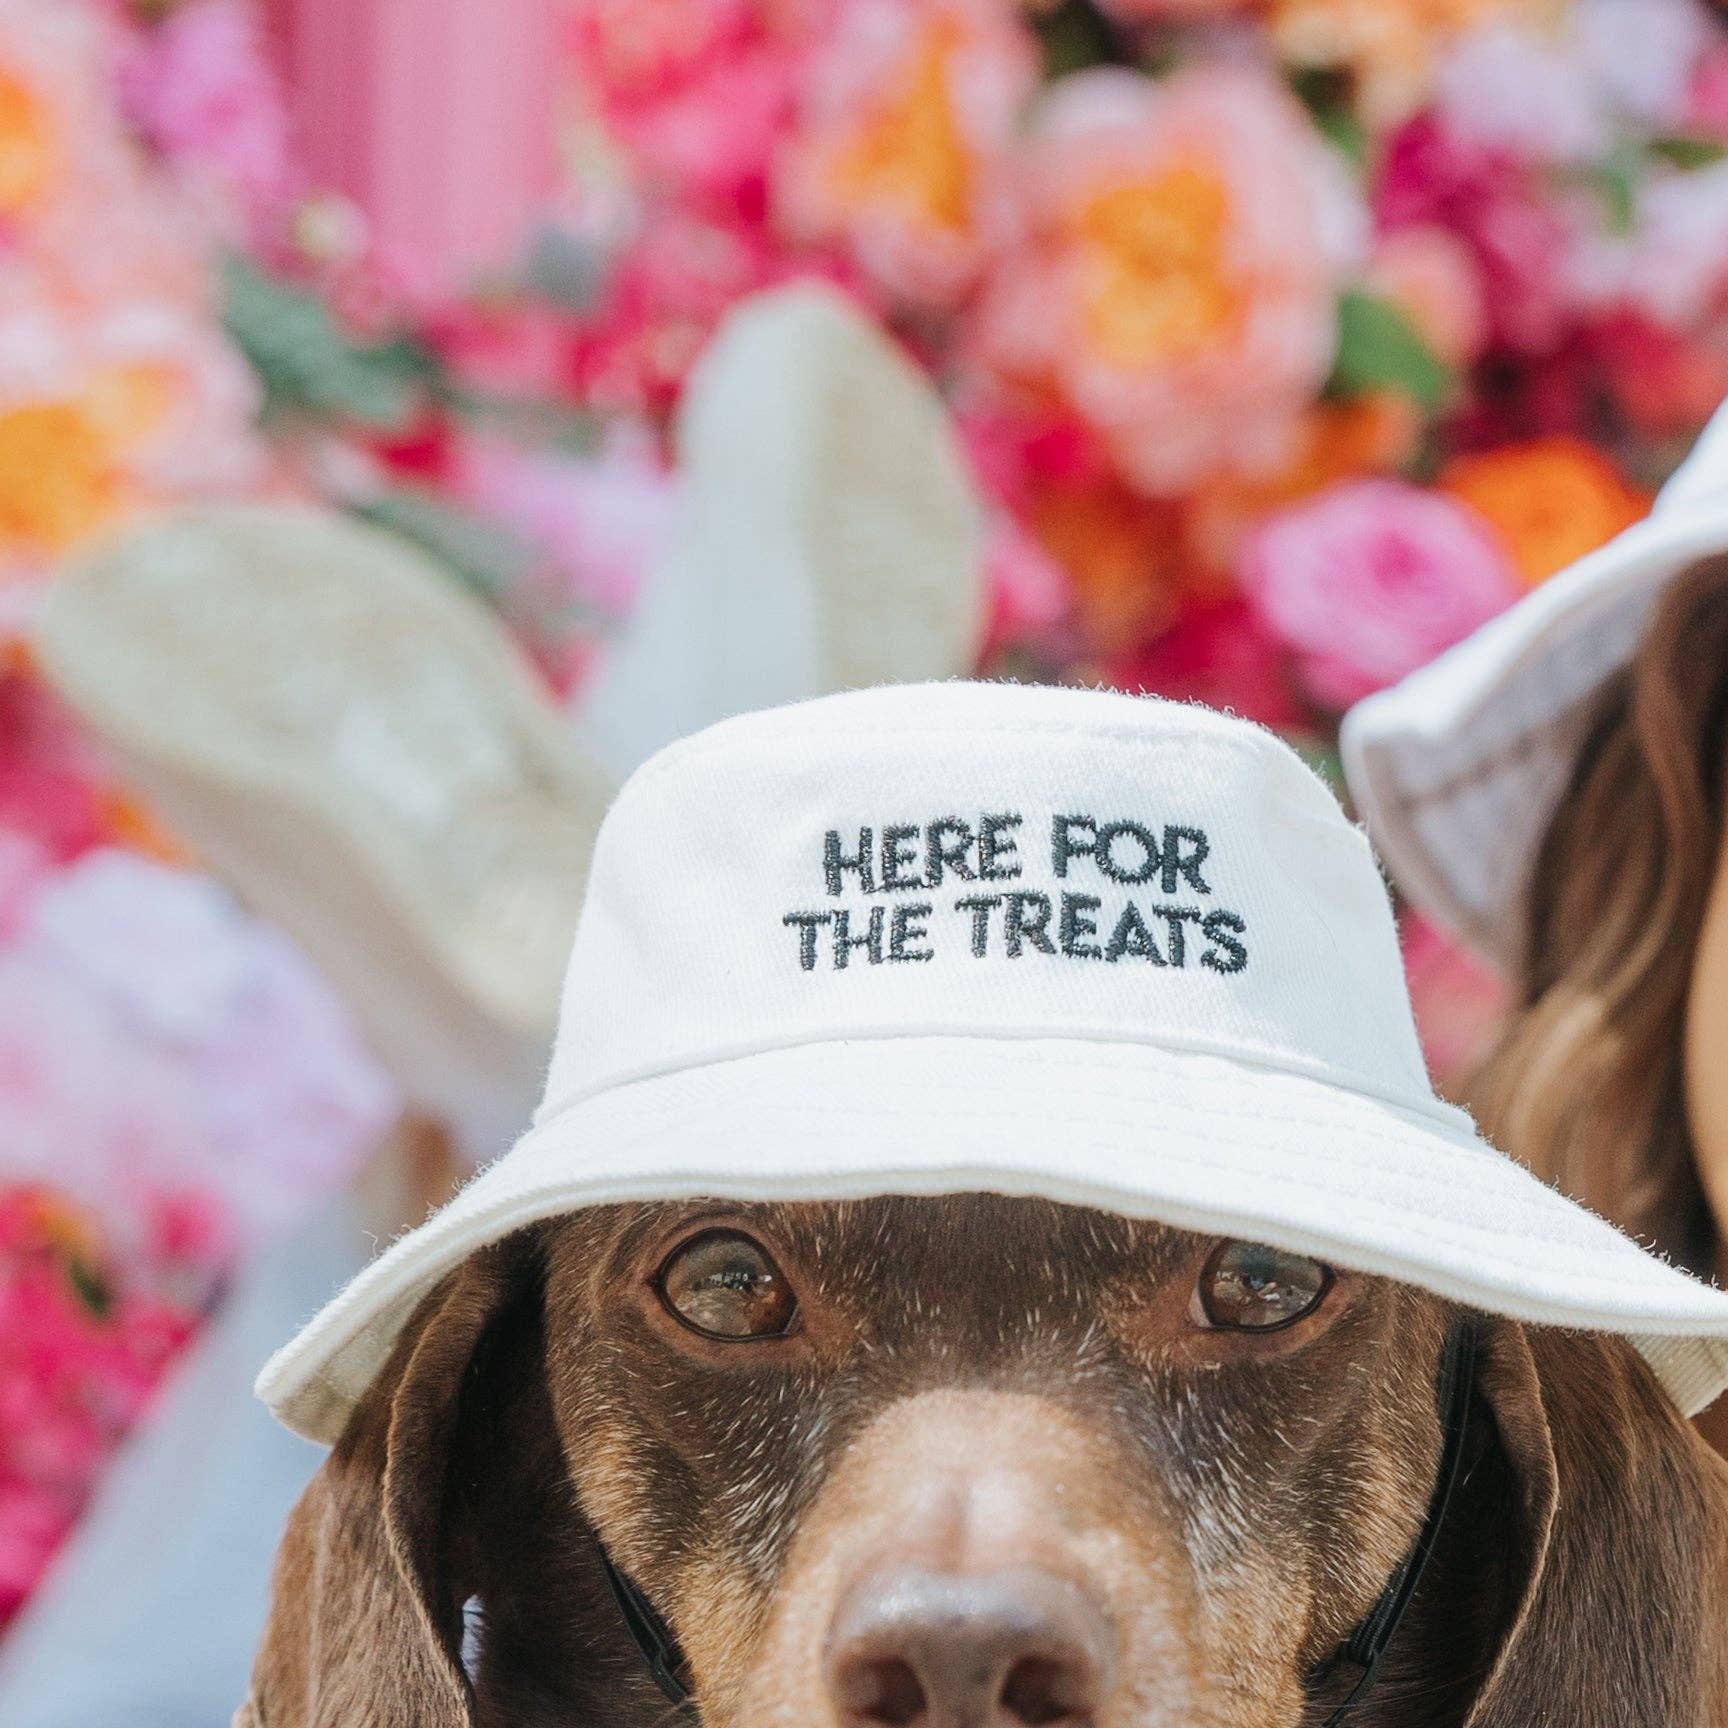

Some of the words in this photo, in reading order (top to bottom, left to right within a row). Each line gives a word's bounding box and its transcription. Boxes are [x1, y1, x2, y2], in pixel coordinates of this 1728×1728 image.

[823, 811, 1023, 896] HERE
[1050, 813, 1212, 895] FOR
[782, 902, 934, 971] THE
[954, 889, 1248, 974] TREATS
